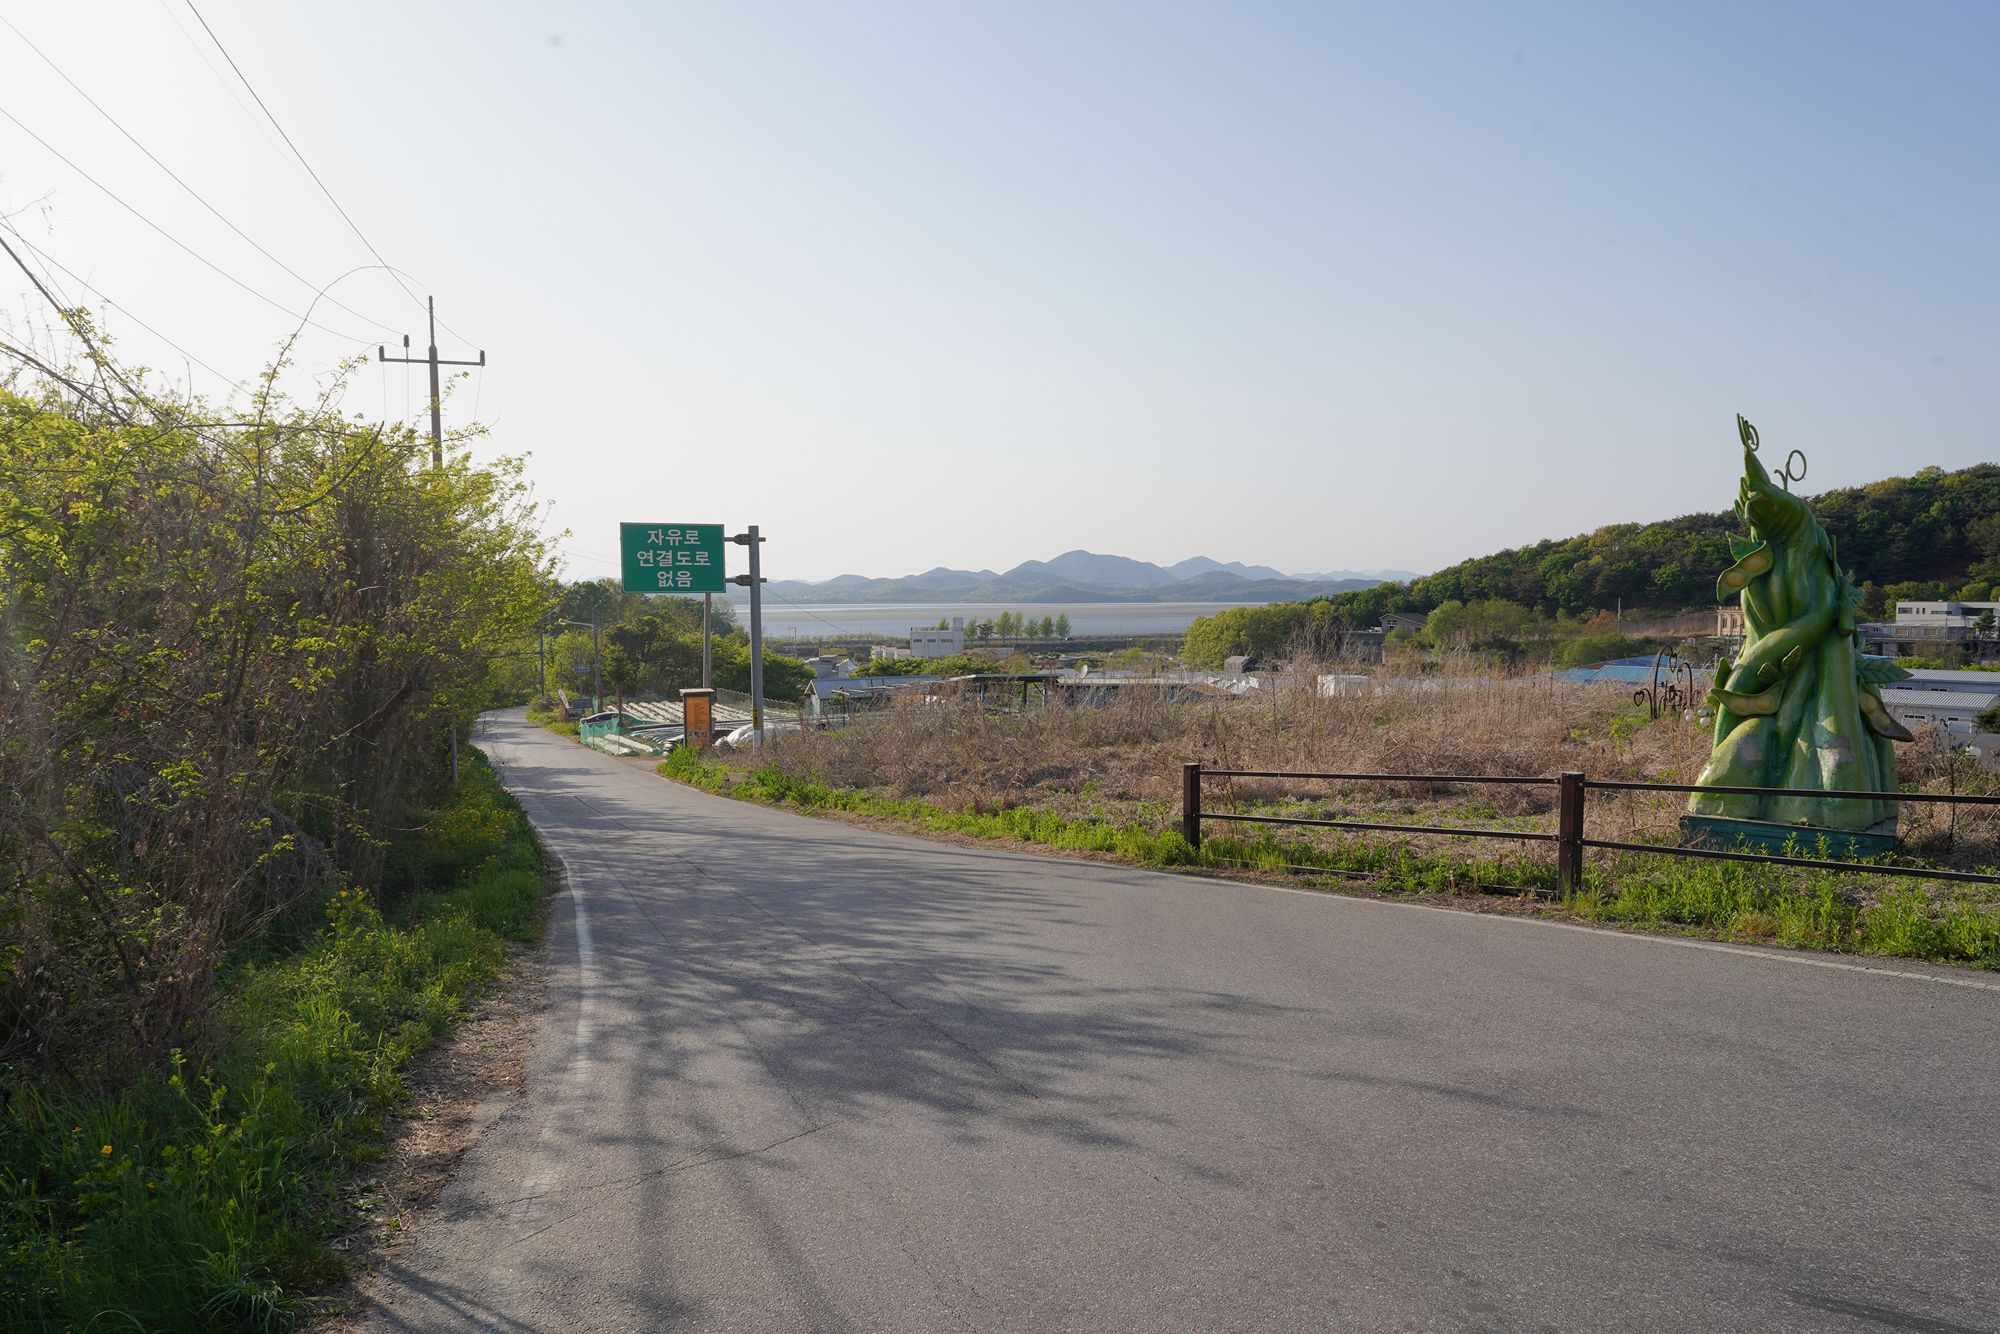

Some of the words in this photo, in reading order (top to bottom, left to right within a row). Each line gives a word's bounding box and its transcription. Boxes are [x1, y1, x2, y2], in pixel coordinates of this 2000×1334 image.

[647, 528, 701, 546] 자유로
[637, 550, 711, 567] 연결도로
[657, 570, 693, 588] 없음
